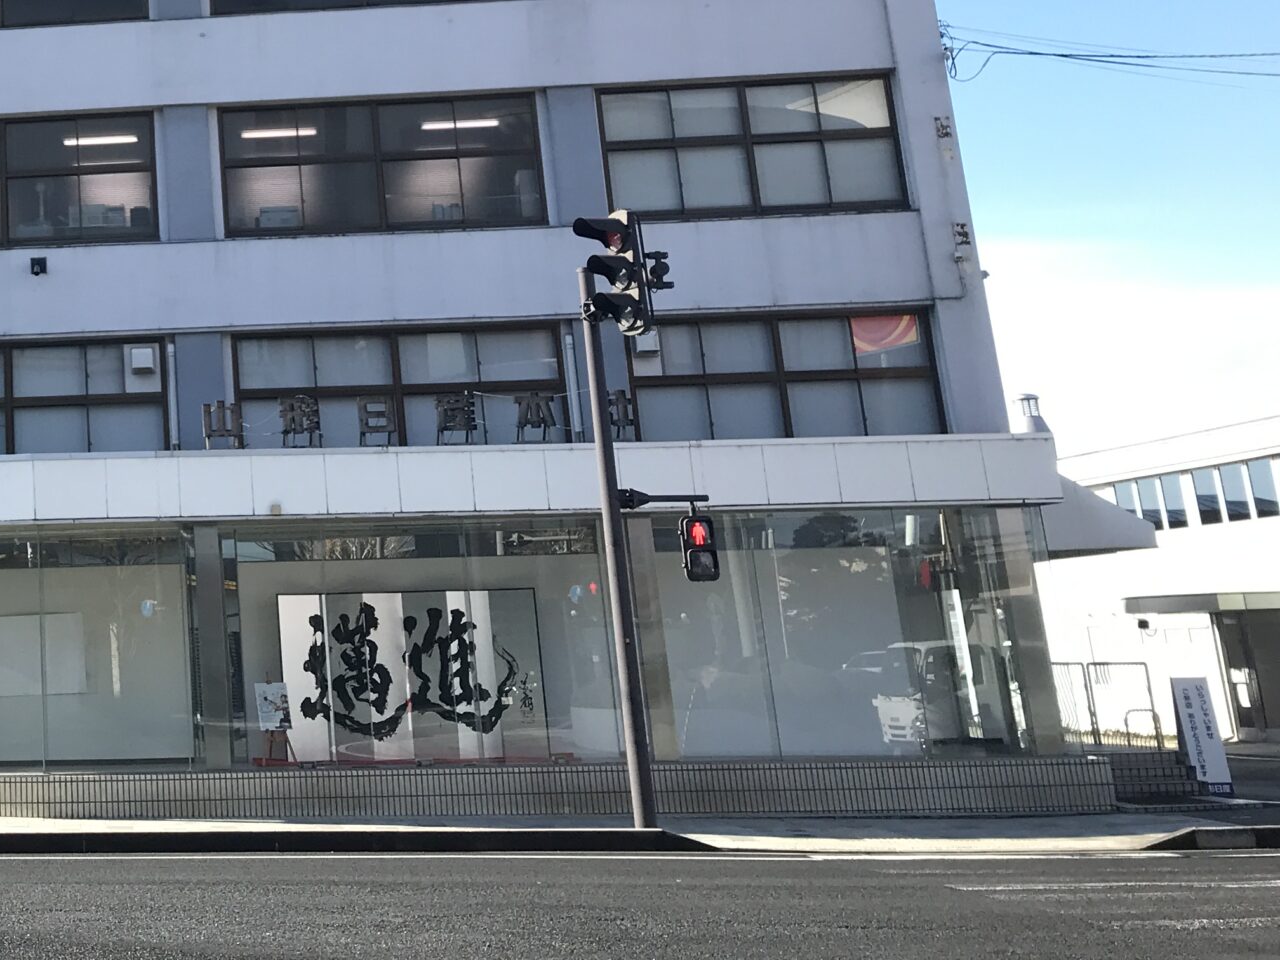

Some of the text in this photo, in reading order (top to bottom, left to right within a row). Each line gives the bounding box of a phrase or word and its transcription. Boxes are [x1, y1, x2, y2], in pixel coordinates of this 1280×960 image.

[1195, 684, 1214, 740] いらっしゃいませ
